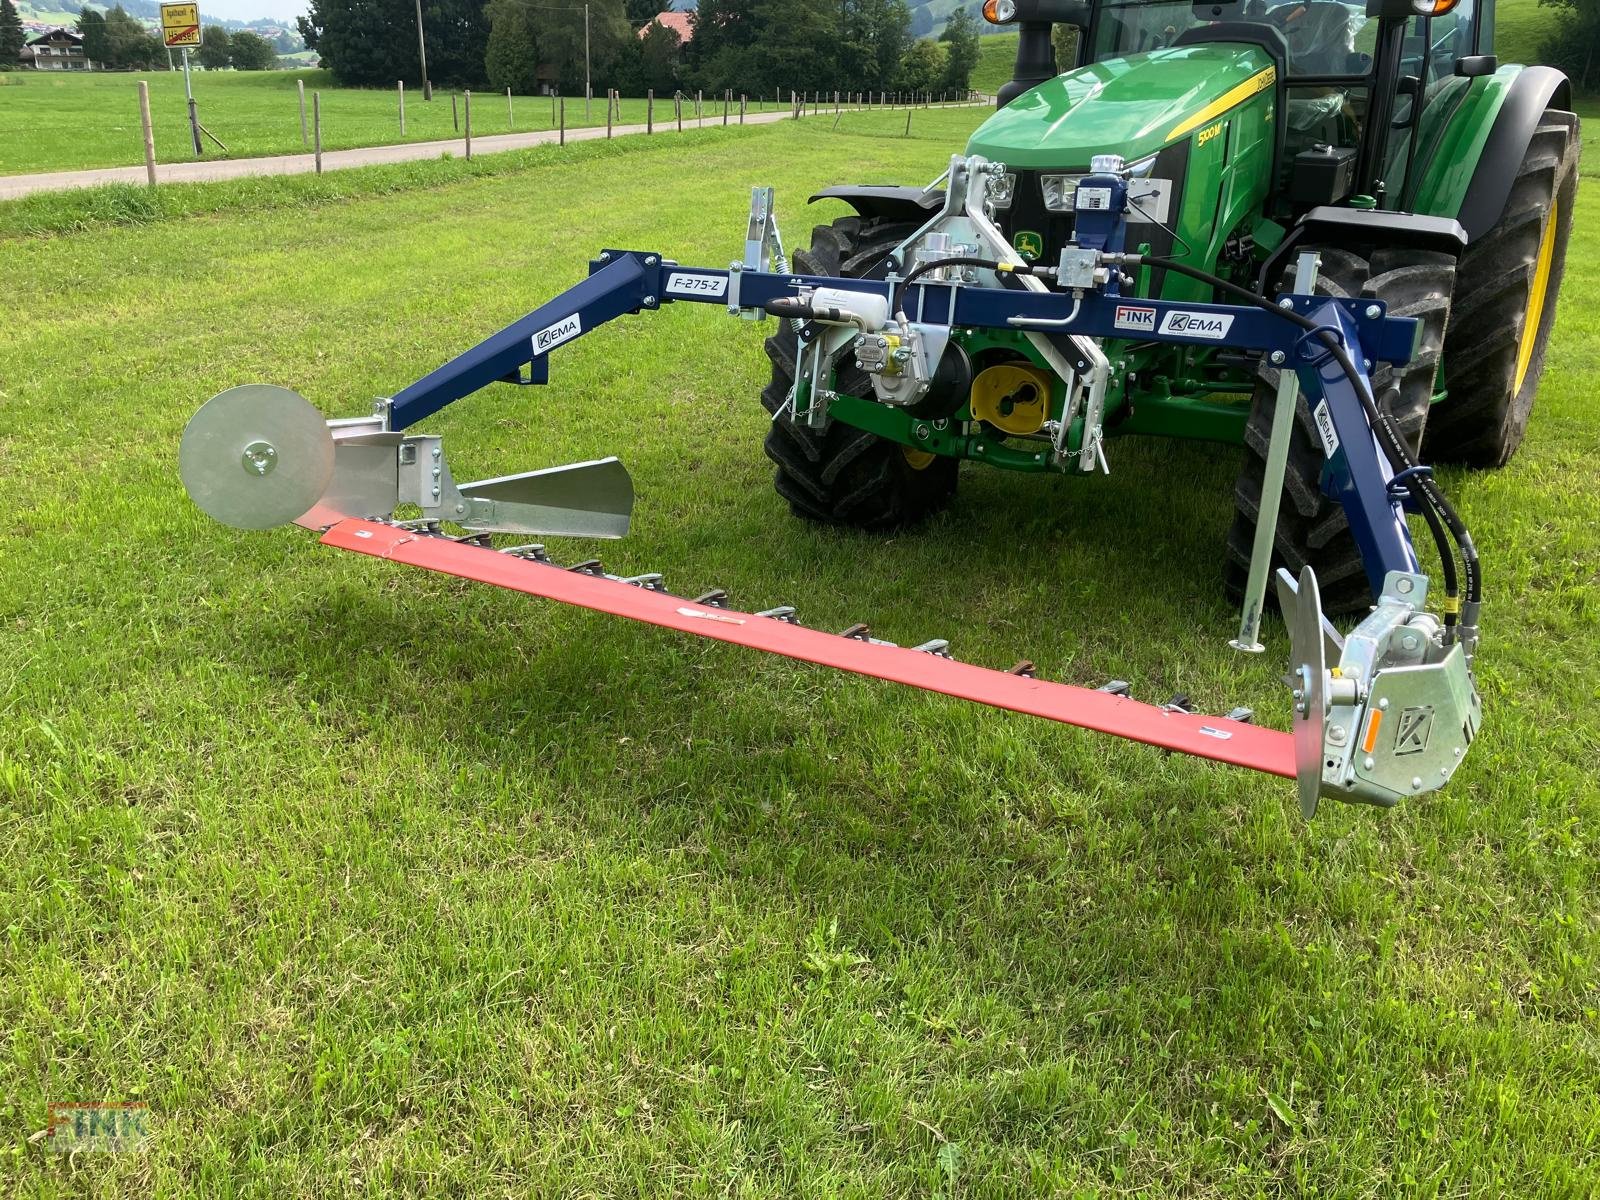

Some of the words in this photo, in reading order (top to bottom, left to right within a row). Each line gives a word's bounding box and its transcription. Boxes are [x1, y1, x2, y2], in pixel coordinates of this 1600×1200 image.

[674, 278, 720, 291] F-275-Z
[1117, 307, 1155, 324] FINK
[1169, 314, 1223, 332] KEMA
[538, 321, 577, 347] KEMA
